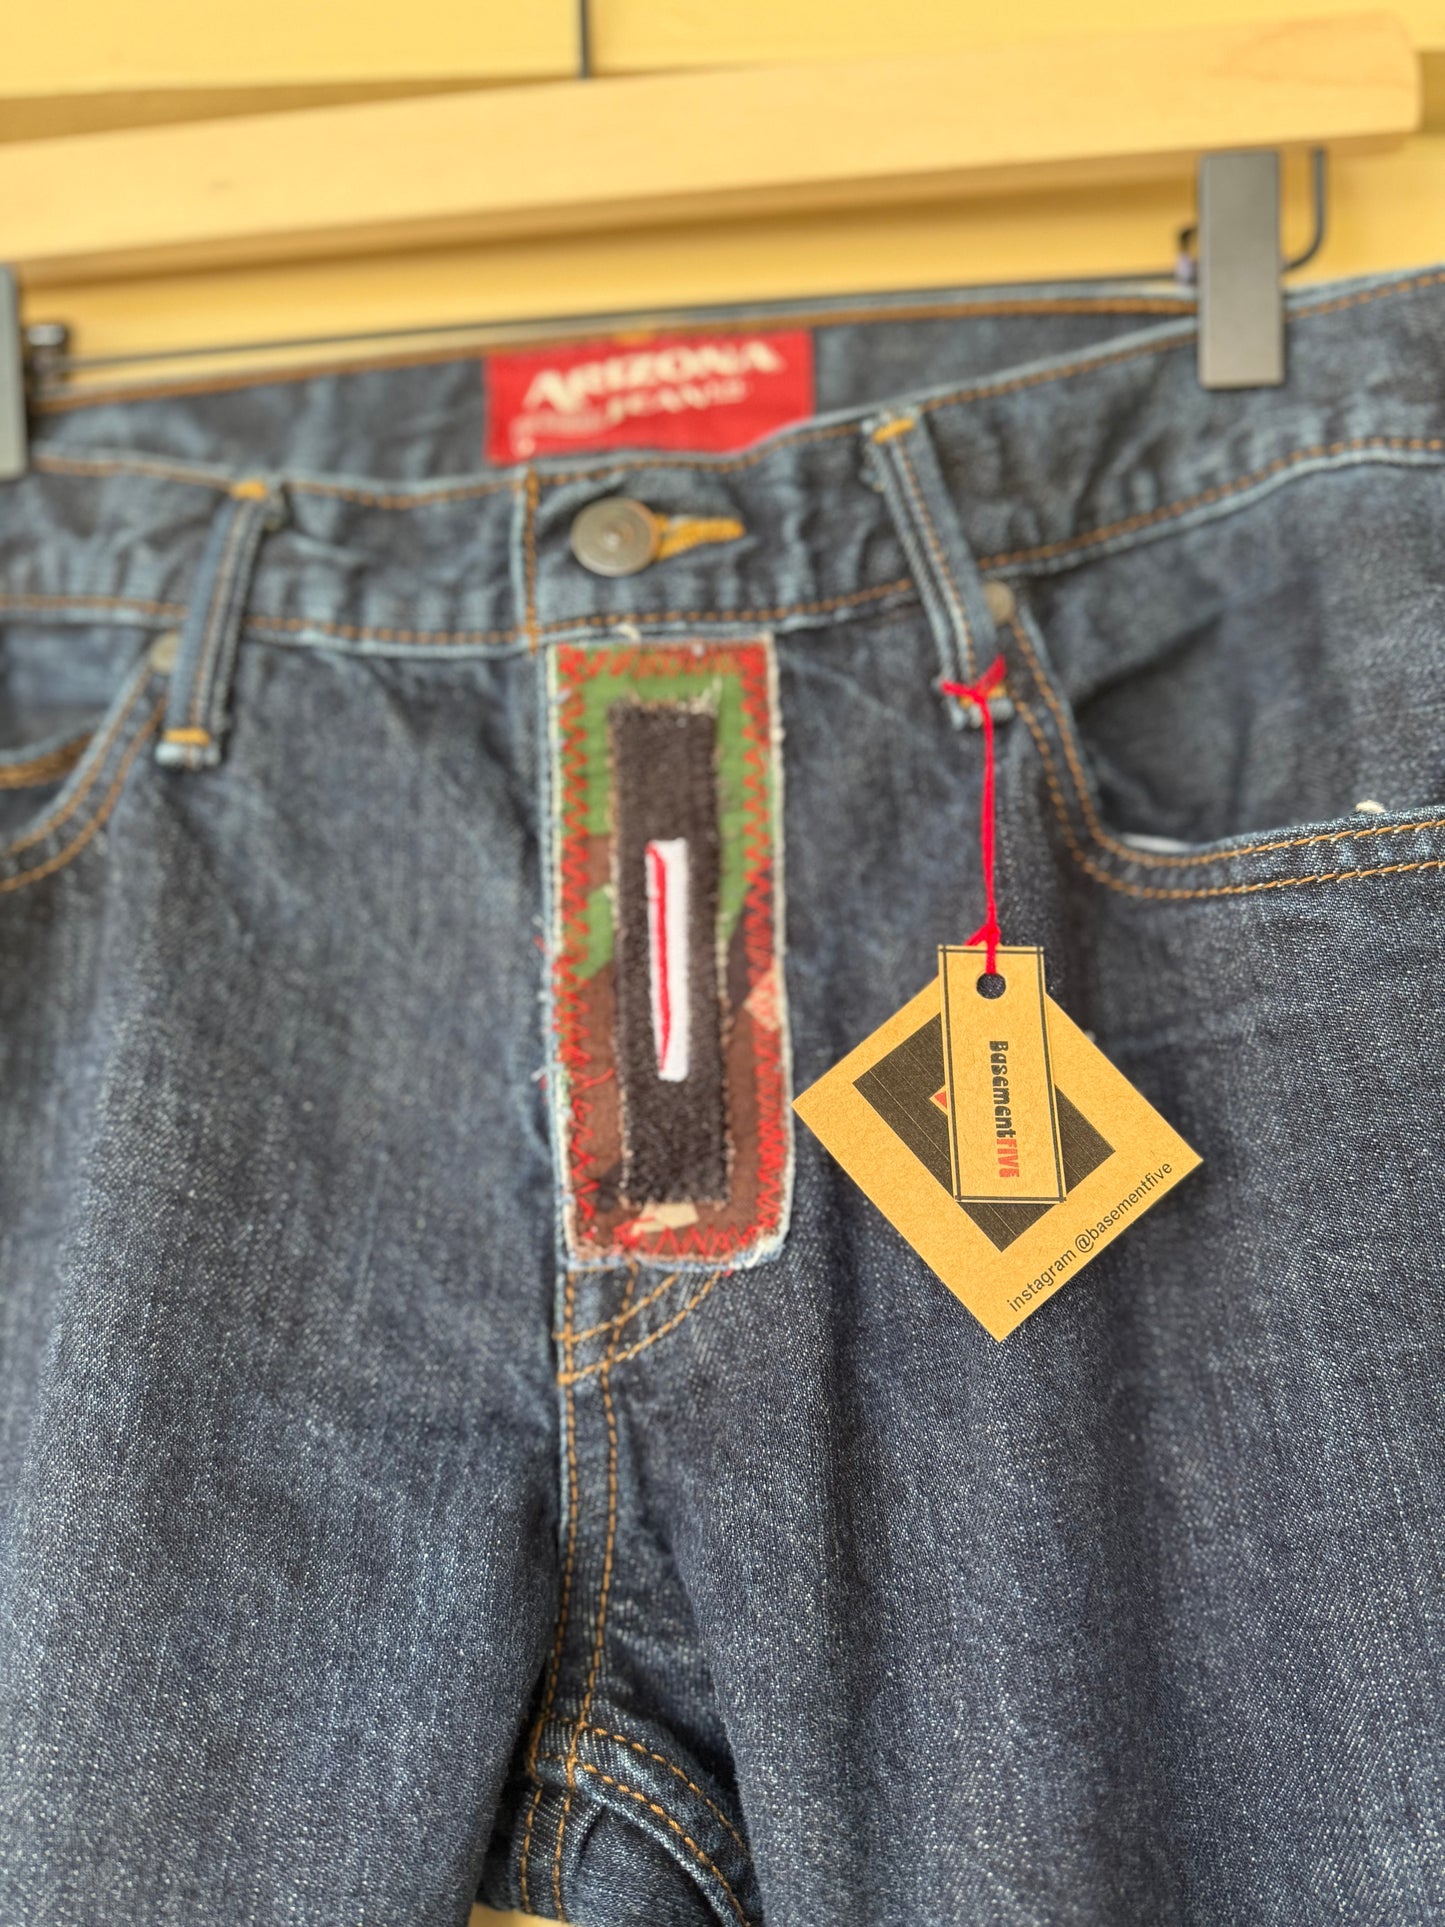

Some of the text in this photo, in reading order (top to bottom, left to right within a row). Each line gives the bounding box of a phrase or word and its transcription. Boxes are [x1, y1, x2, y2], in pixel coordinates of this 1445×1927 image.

[522, 341, 783, 414] ARIZONA
[605, 378, 748, 424] JEANS
[1007, 1161, 1173, 1312] instagram @basementfive
